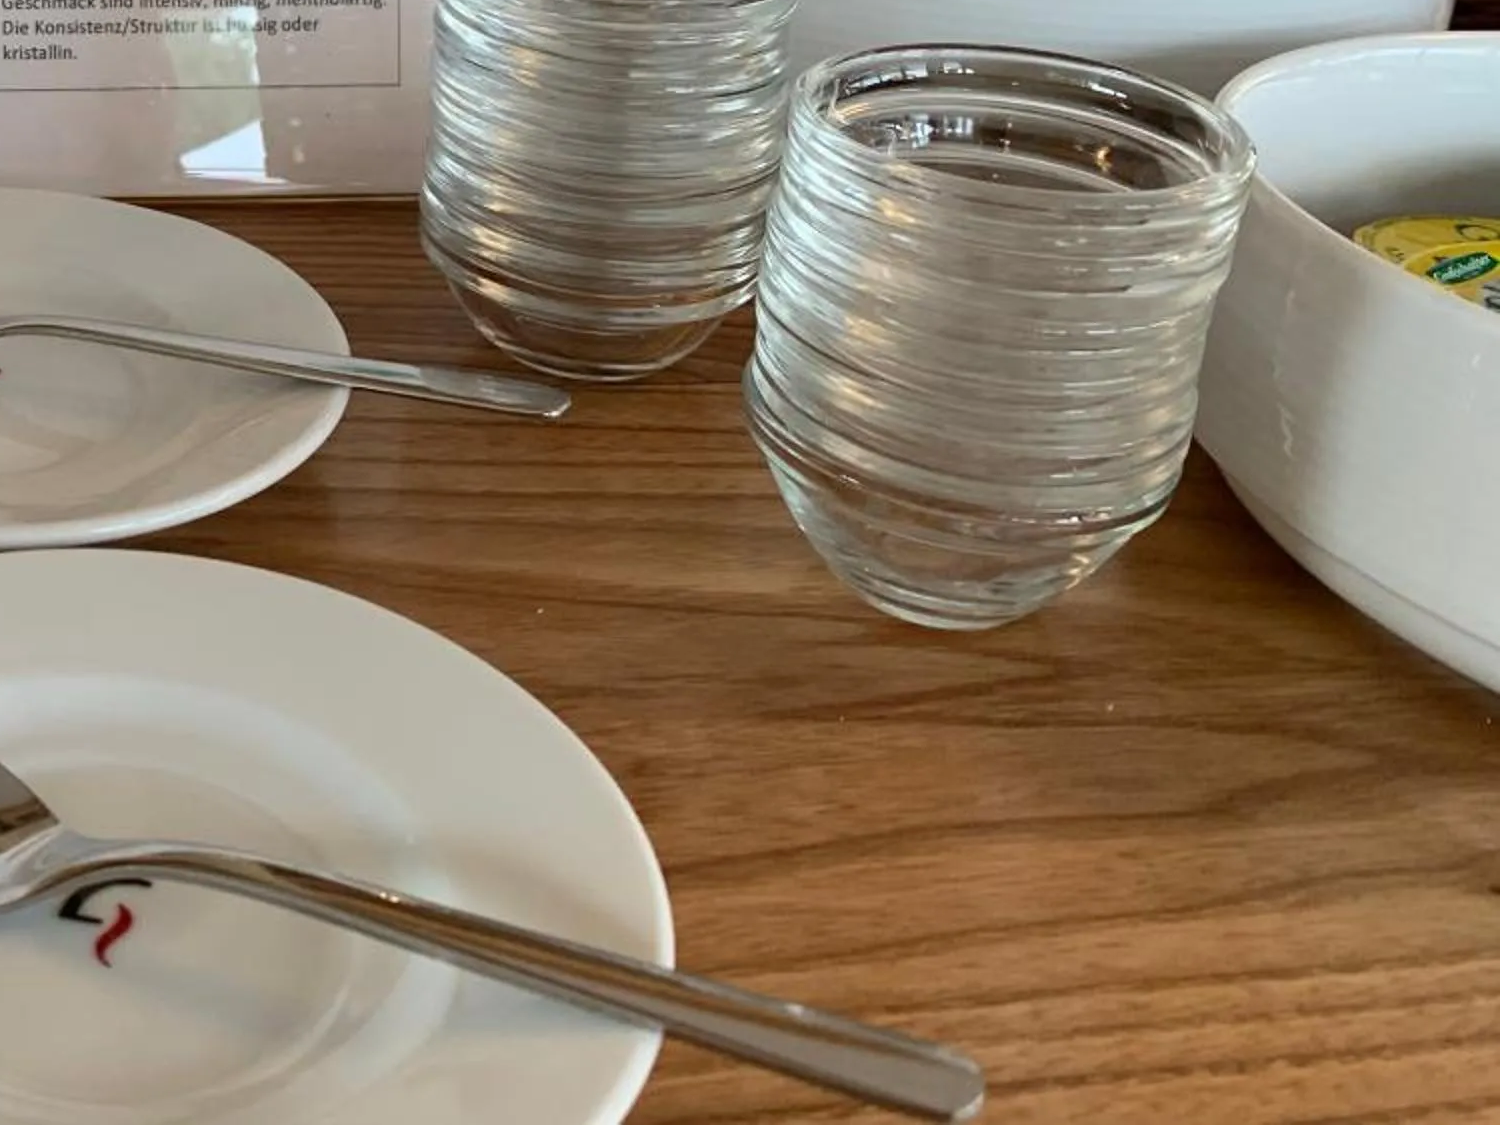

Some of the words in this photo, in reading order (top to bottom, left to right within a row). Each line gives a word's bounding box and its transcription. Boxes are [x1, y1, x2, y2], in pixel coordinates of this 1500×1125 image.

[1, 19, 30, 36] Die
[34, 16, 195, 38] Konsistenz/Struktur
[280, 15, 320, 33] oder
[2, 44, 78, 61] kristallin.
